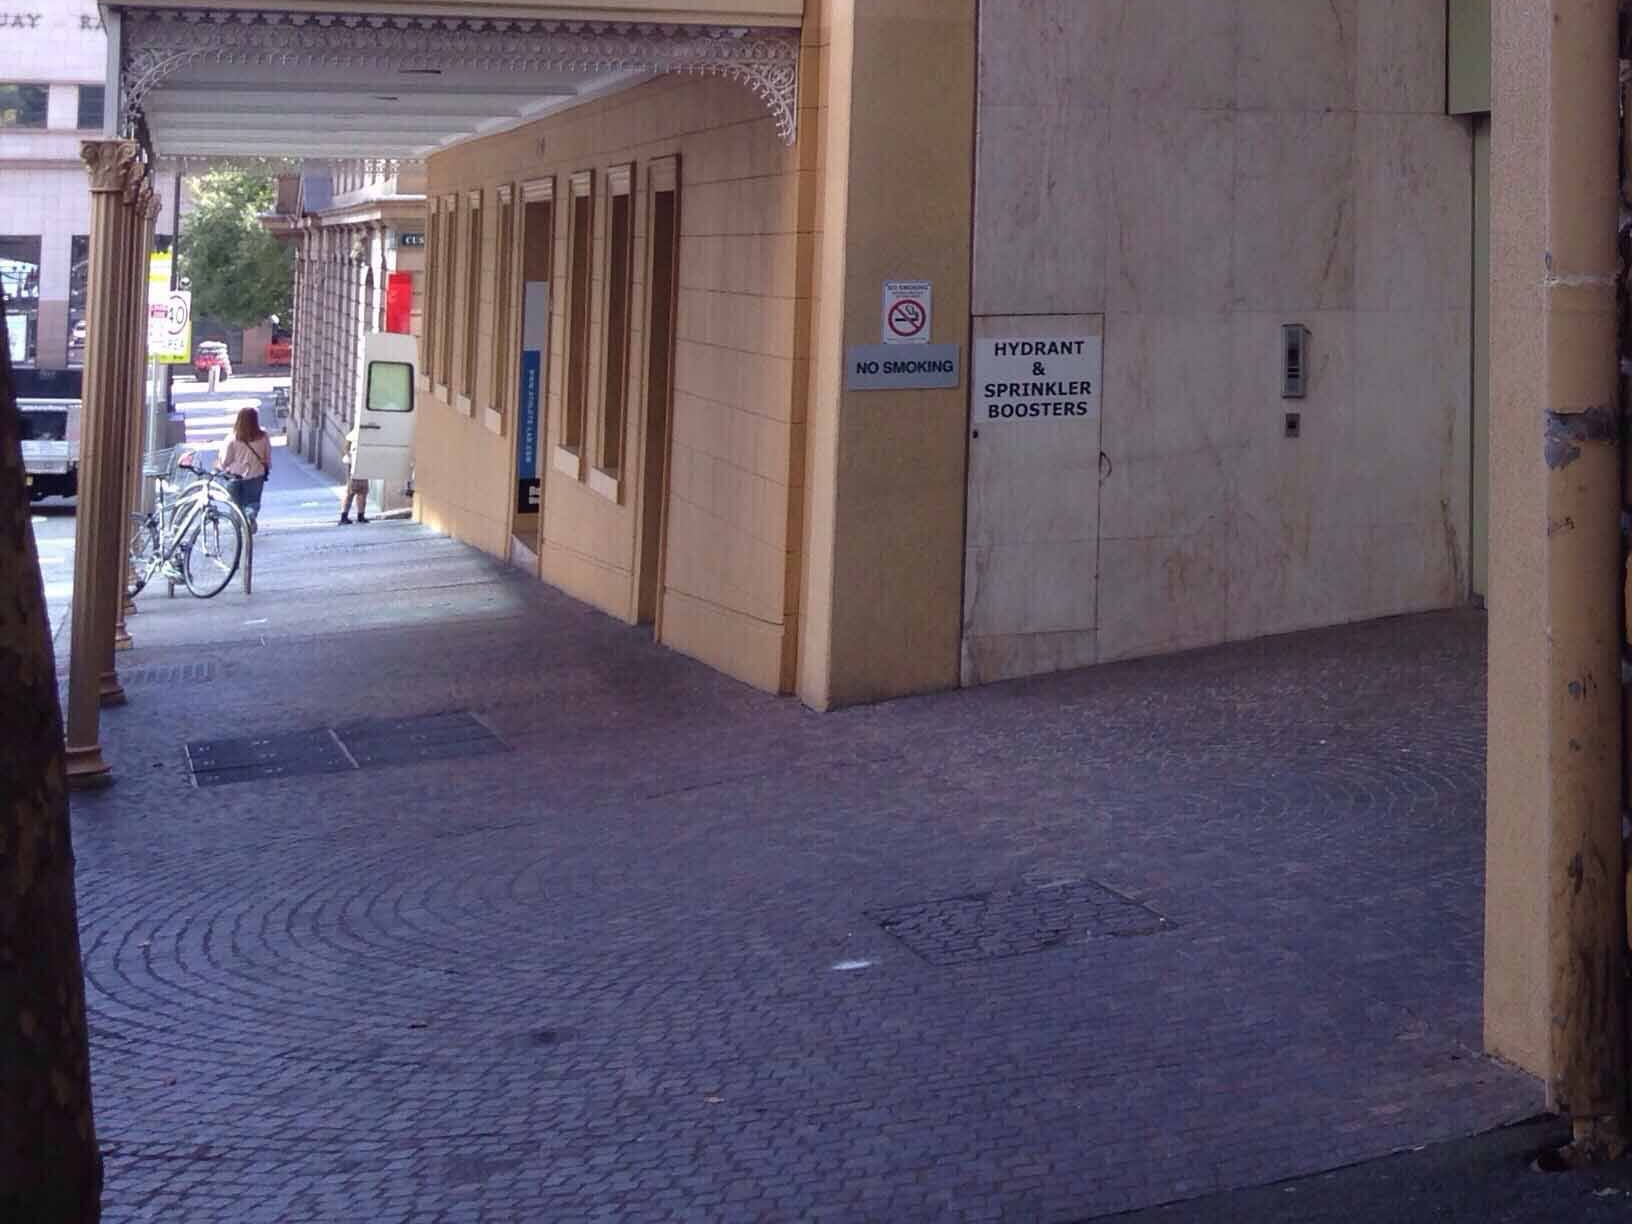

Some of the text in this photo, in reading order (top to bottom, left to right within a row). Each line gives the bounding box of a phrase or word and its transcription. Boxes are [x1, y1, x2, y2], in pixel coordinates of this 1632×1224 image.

[994, 340, 1086, 357] HYDRANT
[855, 359, 955, 375] NO SMOKING
[1032, 361, 1047, 376] &
[984, 380, 1092, 399] SPRINKLER
[988, 401, 1089, 419] BOOSTERS
